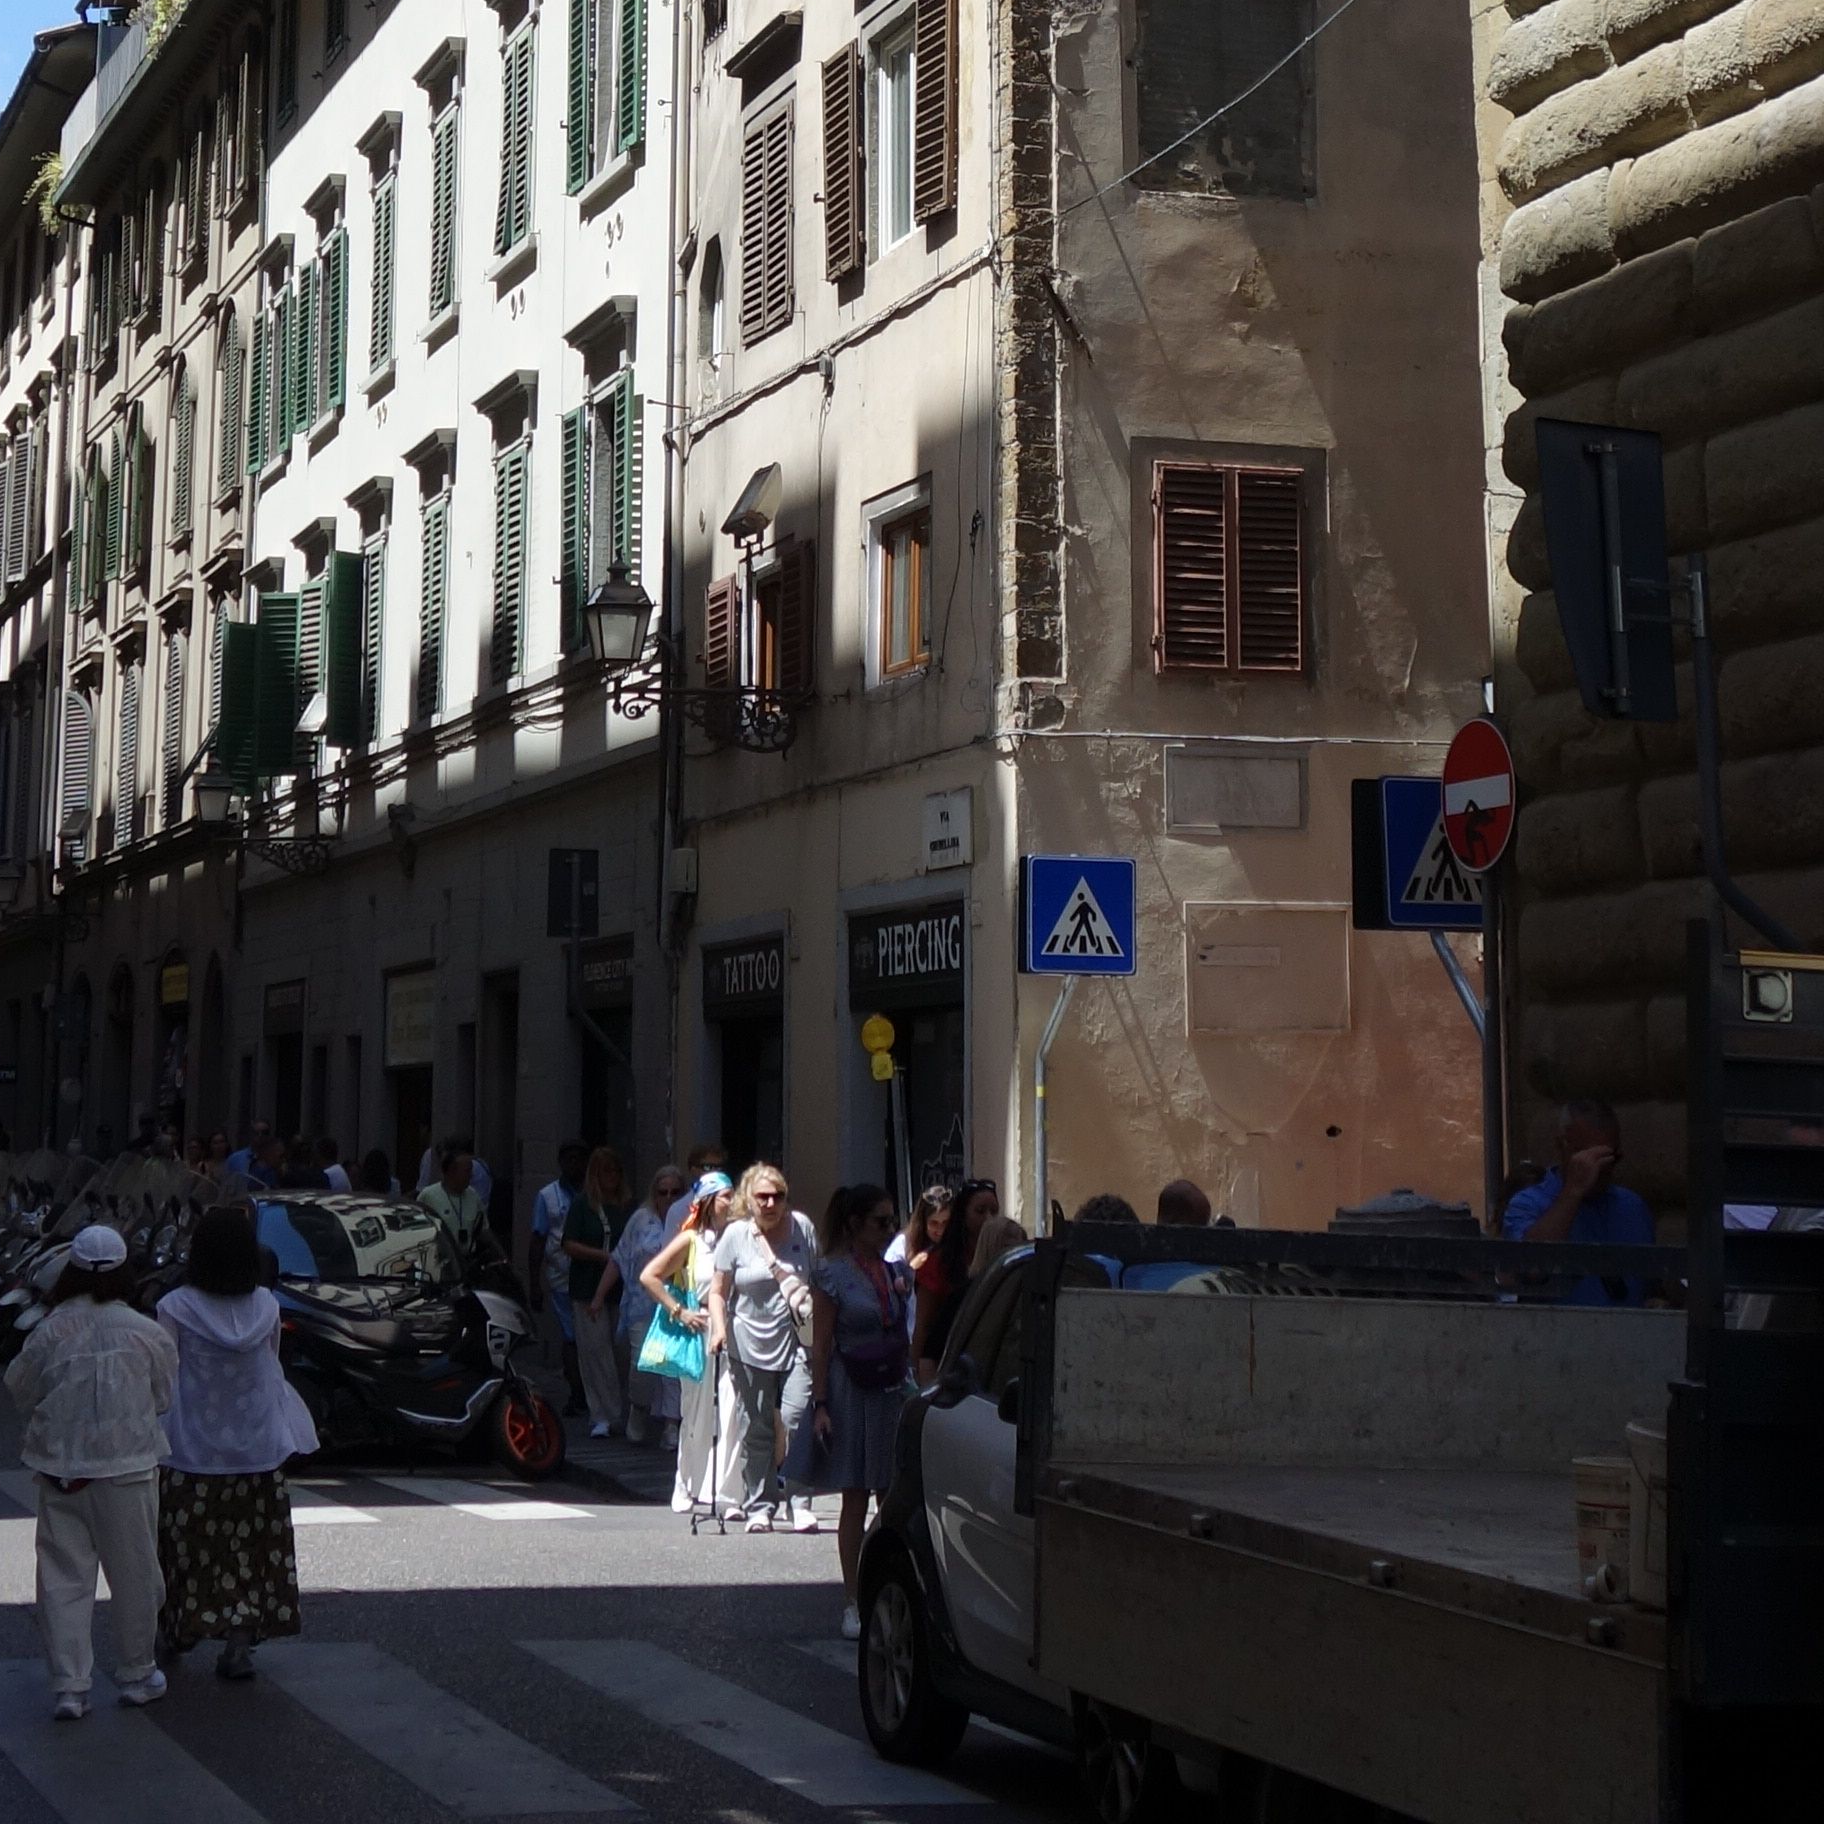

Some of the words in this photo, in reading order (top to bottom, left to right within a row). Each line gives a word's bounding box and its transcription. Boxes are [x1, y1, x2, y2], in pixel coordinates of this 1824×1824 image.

[939, 810, 950, 824] VIA
[876, 914, 962, 977] PIERCING
[722, 948, 781, 995] TATTOO
